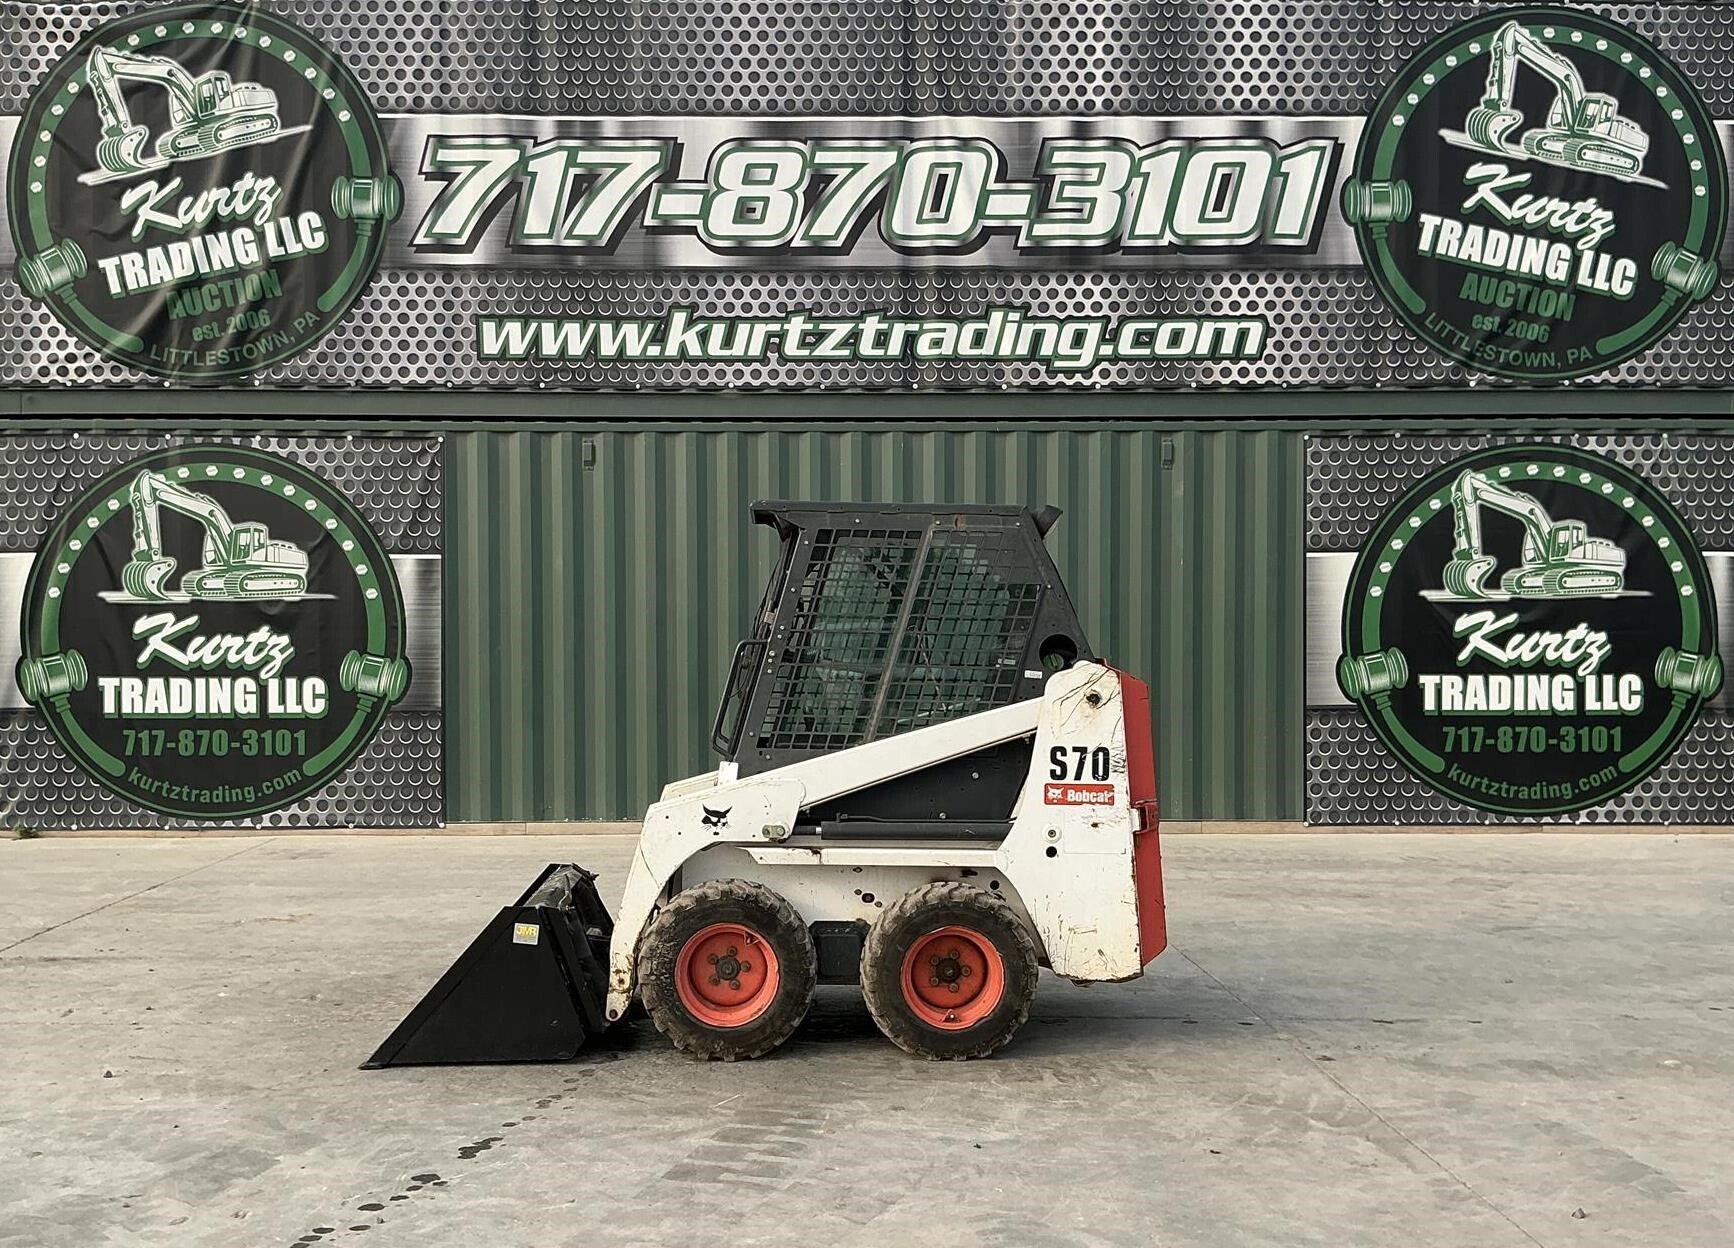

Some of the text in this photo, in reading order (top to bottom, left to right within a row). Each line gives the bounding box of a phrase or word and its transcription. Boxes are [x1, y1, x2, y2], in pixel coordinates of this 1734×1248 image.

[120, 171, 283, 243] Kurtz
[415, 138, 1338, 252] 717-870-3101
[1461, 161, 1615, 250] Kurtz
[98, 211, 328, 298] TRADING LLC
[1417, 213, 1638, 300] TRADING LLC
[166, 269, 283, 320] AUCTION
[1458, 272, 1577, 322] AUCTION
[149, 310, 321, 367] LITTLESTOWN, PA
[226, 308, 272, 336] 2006
[477, 306, 1269, 373] www.kurtztrading.com
[1424, 311, 1593, 370] LITTLESTOWN, PA
[1503, 317, 1551, 344] 2006
[133, 612, 295, 680] Kurtz
[1453, 610, 1612, 677] Kurtz
[98, 677, 328, 718] TRADING LLC
[1418, 674, 1644, 715] TRADING LLC
[122, 729, 307, 757] 717-870-3101
[1050, 746, 1110, 781] S70
[1442, 726, 1623, 754] 717-870-3101
[126, 766, 303, 804] kurtztrading.com
[1067, 789, 1110, 803] Bobcat
[1448, 763, 1618, 801] kurtztrading.com
